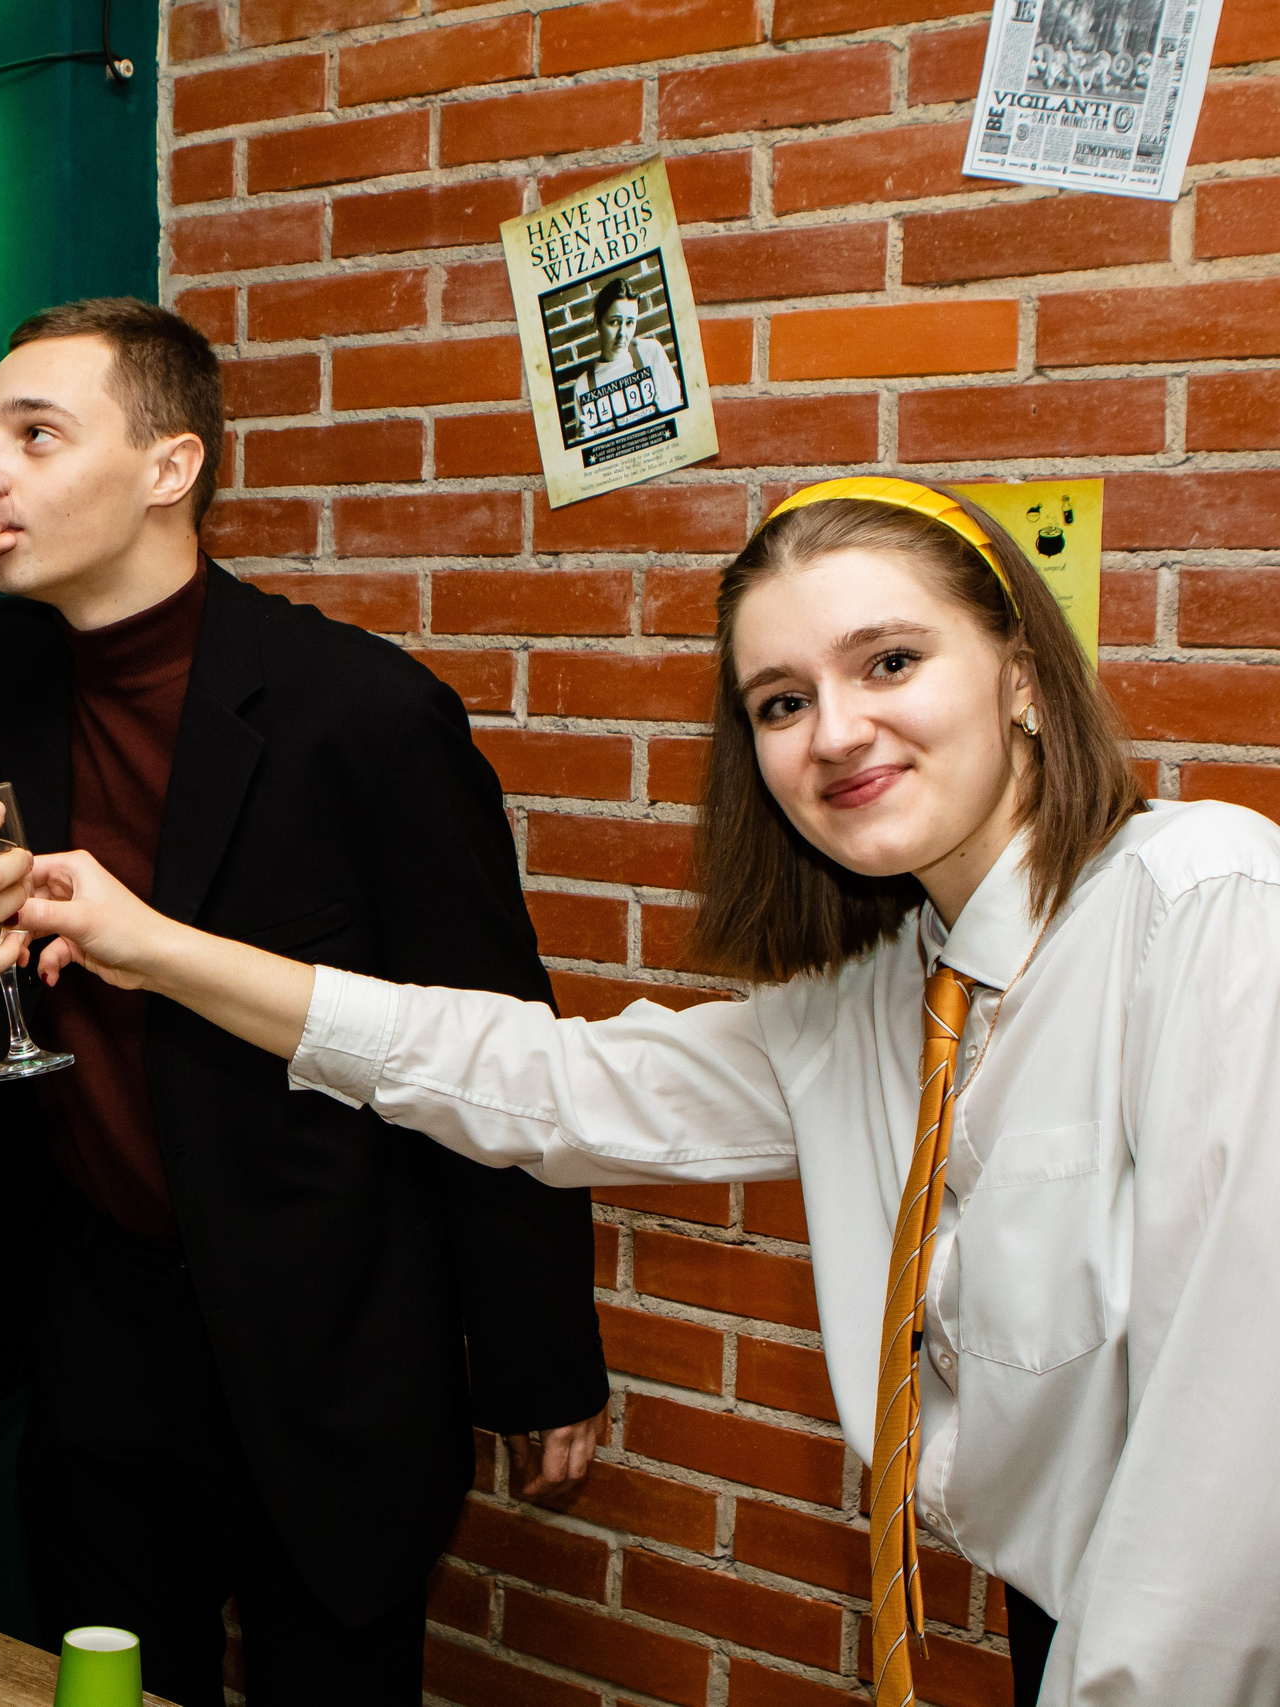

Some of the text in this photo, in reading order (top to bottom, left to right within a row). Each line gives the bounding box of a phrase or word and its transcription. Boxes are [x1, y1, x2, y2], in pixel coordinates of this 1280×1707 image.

[986, 107, 1005, 131] BE
[993, 90, 1112, 117] VIGILANT!
[1031, 111, 1057, 124] SAYS
[1060, 114, 1109, 132] MINISTER
[526, 175, 648, 245] HAVE YOU
[529, 199, 653, 267] SEEN THIS
[541, 226, 646, 284] WIZARD?
[581, 369, 650, 404] AZKABAN PRISON
